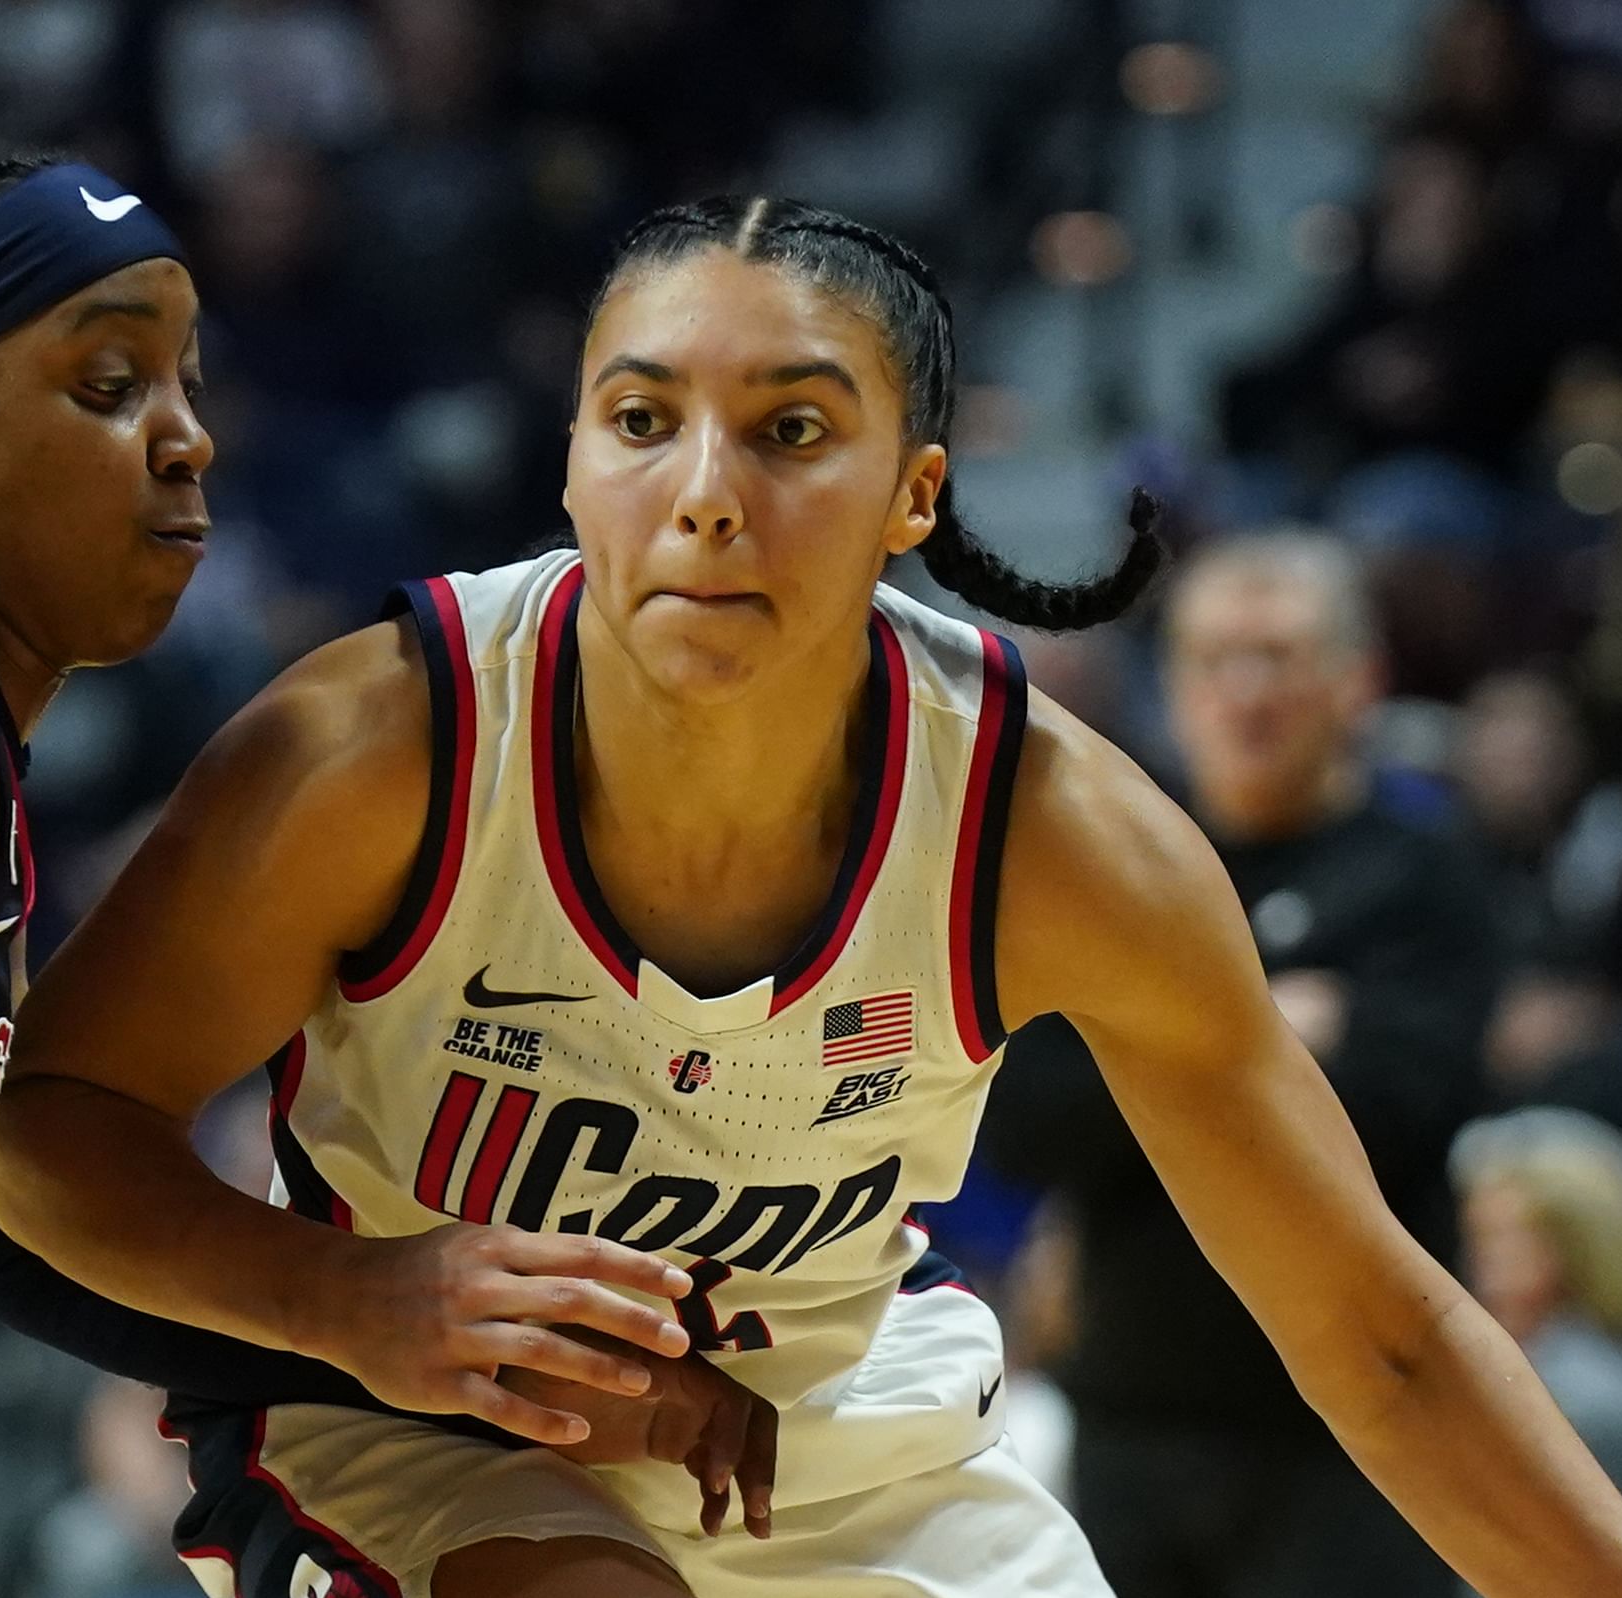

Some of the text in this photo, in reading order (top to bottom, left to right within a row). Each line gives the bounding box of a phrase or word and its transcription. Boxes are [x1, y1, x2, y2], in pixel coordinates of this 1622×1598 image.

[454, 1018, 543, 1053] BE THE
[443, 1039, 543, 1072] CHANGE
[821, 1074, 912, 1114] EAST
[834, 1065, 904, 1096] BIG
